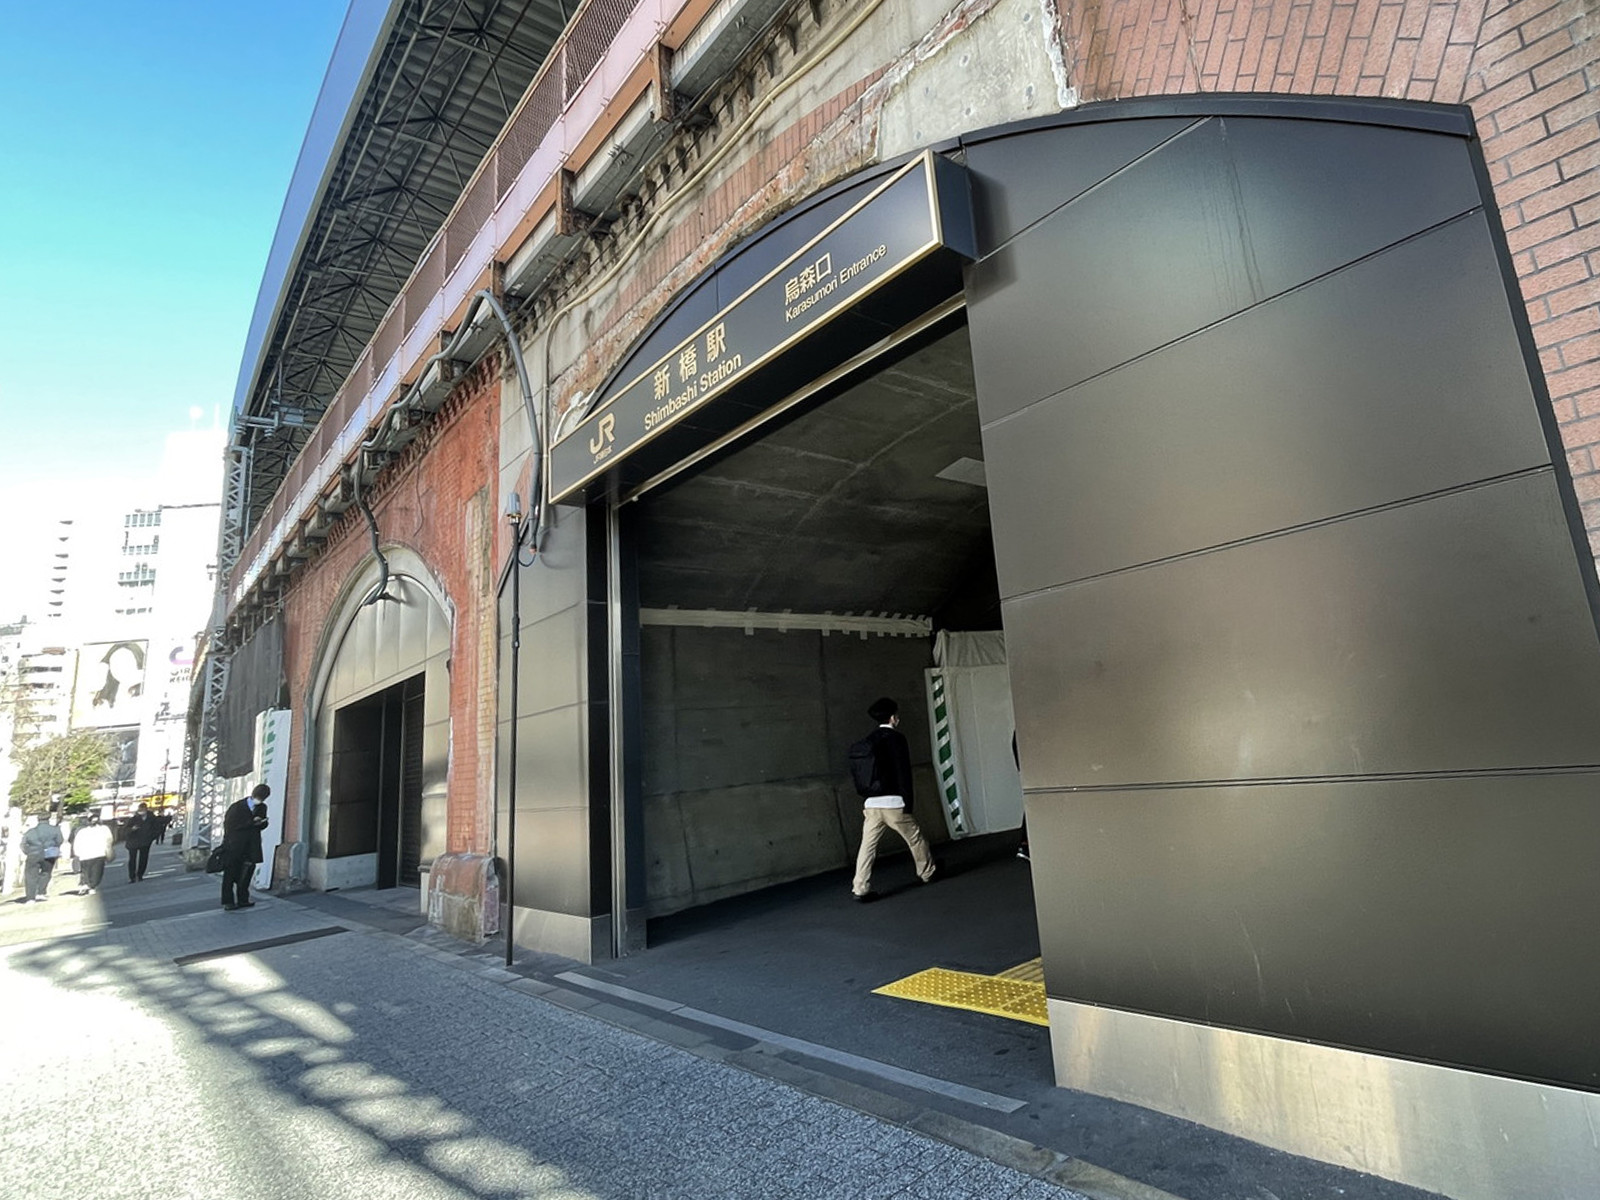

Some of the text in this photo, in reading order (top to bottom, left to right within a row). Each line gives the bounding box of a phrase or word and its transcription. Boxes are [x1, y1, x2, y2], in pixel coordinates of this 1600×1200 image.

[785, 244, 887, 323] Karasumori Entrance
[644, 353, 742, 431] Shimbashi Station
[653, 322, 726, 400] 新橋駅
[590, 412, 616, 455] JR
